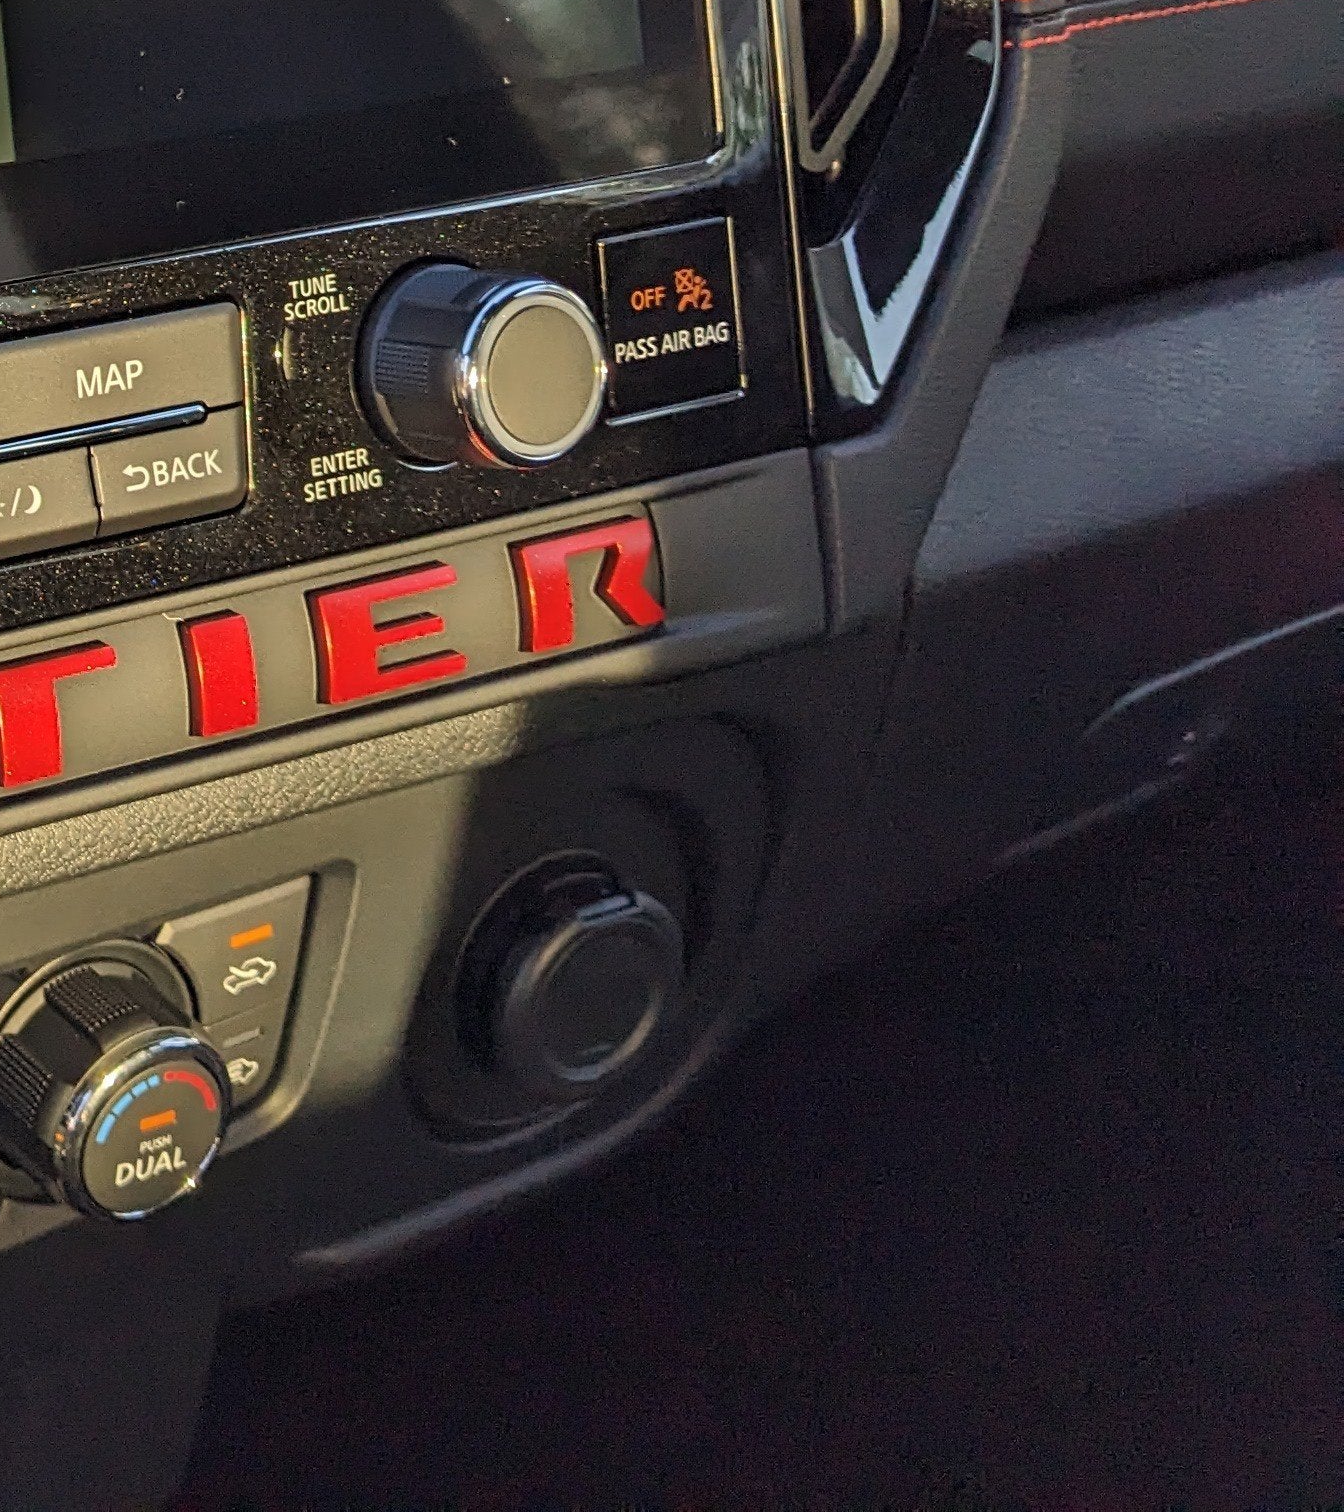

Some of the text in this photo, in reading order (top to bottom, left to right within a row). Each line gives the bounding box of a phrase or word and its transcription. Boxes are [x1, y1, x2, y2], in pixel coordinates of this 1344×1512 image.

[288, 273, 338, 300] TUNE
[630, 286, 666, 311] OFF
[284, 293, 350, 321] SCROLL
[614, 321, 730, 364] PASS AIR BAG
[75, 359, 144, 399] MAP
[153, 449, 222, 487] BACK
[310, 448, 370, 477] ENTER
[303, 468, 383, 503] SETTING
[115, 1146, 187, 1187] DUAL
